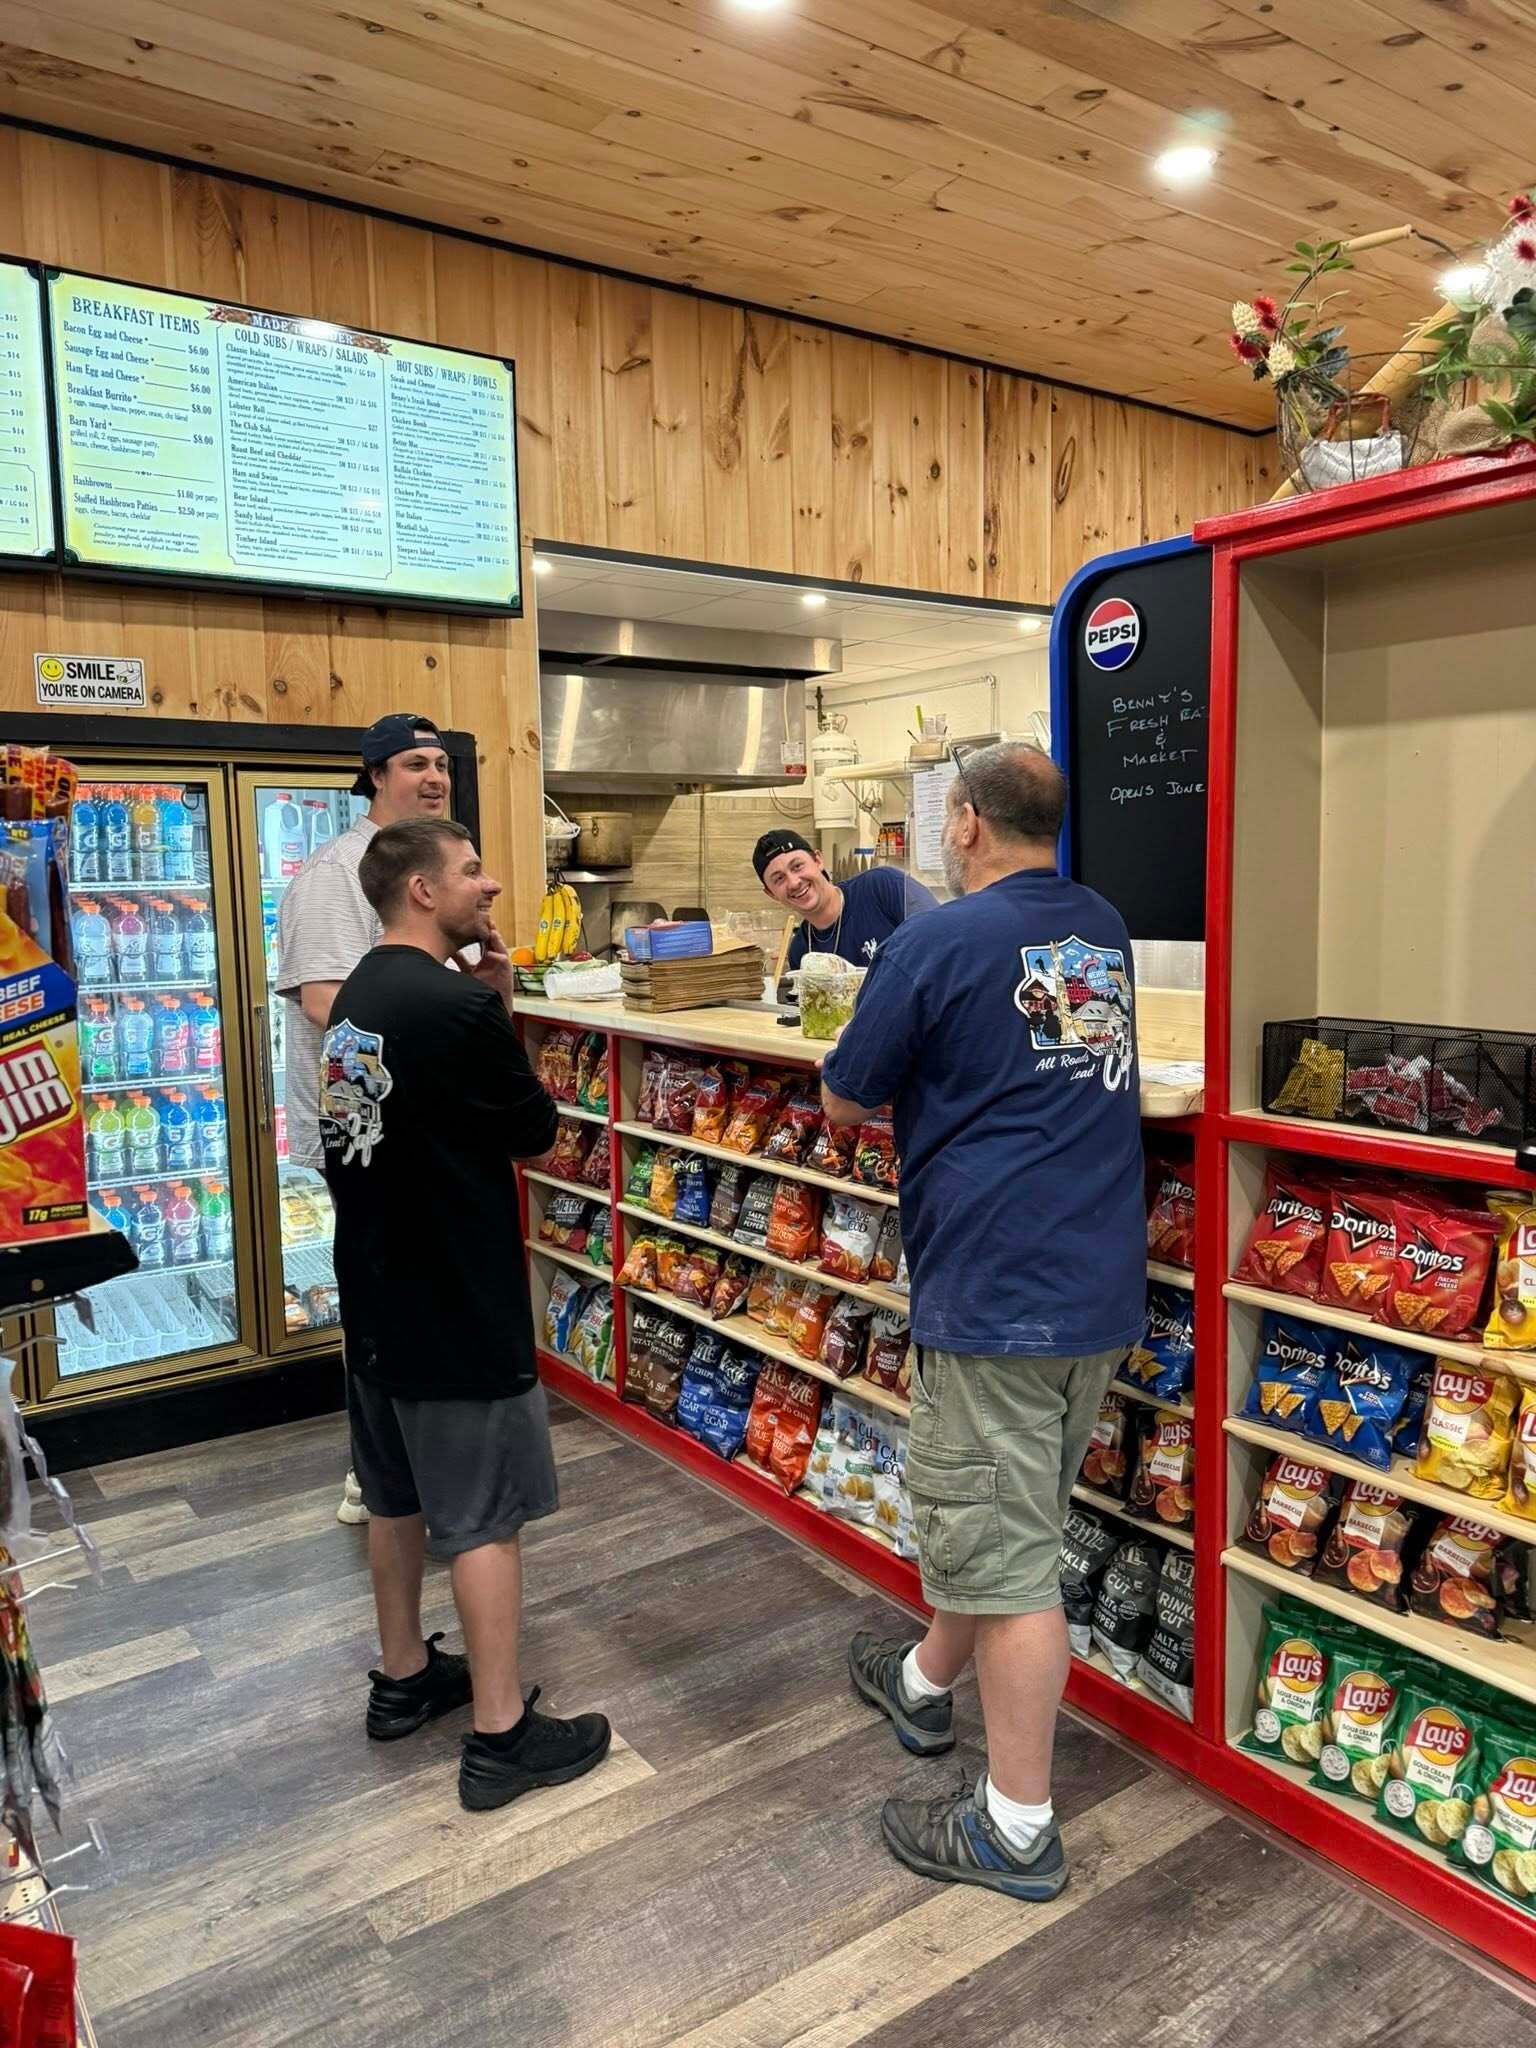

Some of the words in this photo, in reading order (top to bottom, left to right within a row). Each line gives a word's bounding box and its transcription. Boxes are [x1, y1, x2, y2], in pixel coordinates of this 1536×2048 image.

[71, 295, 155, 327] BREAKFAST
[160, 313, 201, 335] ITEMS
[63, 320, 86, 335] Bacon
[88, 325, 101, 340] Egg
[104, 328, 117, 341] and
[119, 330, 143, 345] Cheese
[188, 344, 209, 357] $6.00
[234, 327, 260, 344] COLD
[262, 333, 288, 350] SUBS
[296, 340, 327, 358] WRAPS
[335, 347, 369, 365] SALADS
[64, 341, 93, 357] Sausage
[95, 346, 108, 361] Egg
[110, 348, 124, 361] and
[125, 351, 150, 365] Cheese
[189, 364, 210, 376] $6.00
[249, 347, 271, 359] Italian
[65, 361, 83, 374] Ham
[85, 365, 99, 379] Egg
[100, 367, 114, 379] and
[116, 369, 140, 383] Cheese
[190, 383, 211, 395] $6.00
[227, 376, 257, 389] American
[258, 382, 278, 392] Italian
[396, 359, 412, 374] HOT
[414, 361, 434, 377] SUBS
[440, 367, 466, 384] WRAPS
[472, 375, 498, 390] BOWLS
[67, 382, 103, 399] Breakfast
[105, 388, 132, 403] Burrito
[191, 404, 212, 415] $8.00
[229, 401, 252, 412] Lobster
[69, 414, 88, 428] Barn
[89, 417, 107, 430] Yard
[229, 419, 242, 428] The
[259, 424, 272, 434] Sub
[249, 446, 263, 457] Beef
[264, 449, 276, 458] and
[276, 451, 302, 463] Cheddar
[72, 475, 113, 490] Hashbrowns
[232, 468, 247, 478] Ham
[248, 470, 260, 480] and
[73, 492, 98, 506] Stuffed
[99, 495, 136, 509] Hashbrown
[136, 500, 159, 512] Patties
[1087, 622, 1137, 647] PEPSI
[66, 662, 116, 681] SMILE
[41, 682, 78, 698] YOU'RE
[80, 685, 96, 699] ON
[97, 686, 142, 701] CAMERA
[1106, 714, 1169, 738] FRESH
[1122, 749, 1199, 769] MARKET
[2, 1028, 29, 1043] REAL
[28, 1012, 66, 1033] CHEESE
[1034, 1056, 1056, 1072] All
[1060, 1050, 1090, 1068] Roads
[1069, 1063, 1096, 1081] Lead
[27, 1208, 49, 1223] 17g
[753, 1201, 767, 1210] CUT
[1266, 1198, 1324, 1223] Doritos
[1330, 1211, 1397, 1240] Doritos
[1399, 1243, 1465, 1272] Doritos
[1434, 1281, 1458, 1289] CHEESE
[1265, 1339, 1327, 1369] Doritos
[1433, 1366, 1486, 1402] Lay's
[1158, 1421, 1191, 1446] Lay's
[1431, 1416, 1465, 1434] CLASSIC
[1275, 1456, 1325, 1490] Lay's
[1271, 1496, 1303, 1516] BARBECUE
[1348, 1518, 1381, 1535] BARBECUE
[1437, 1544, 1472, 1566] BARBECUE
[1105, 1572, 1132, 1595] CUT
[1160, 1609, 1186, 1629] CUT
[1277, 1650, 1323, 1682] Lay's
[1276, 1688, 1293, 1700] SOUR
[1292, 1695, 1312, 1707] CREAM
[1286, 1698, 1305, 1710] ONION
[1342, 1682, 1390, 1715] Lay's
[1342, 1723, 1359, 1733] SOUR
[1359, 1727, 1378, 1739] CREAM
[1353, 1733, 1372, 1743] ONION
[1414, 1717, 1466, 1755] Lay's
[1412, 1760, 1430, 1772] SOUR
[1430, 1767, 1451, 1780] CREAM
[1423, 1771, 1444, 1784] ONION
[1500, 1770, 1536, 1807] Lay
